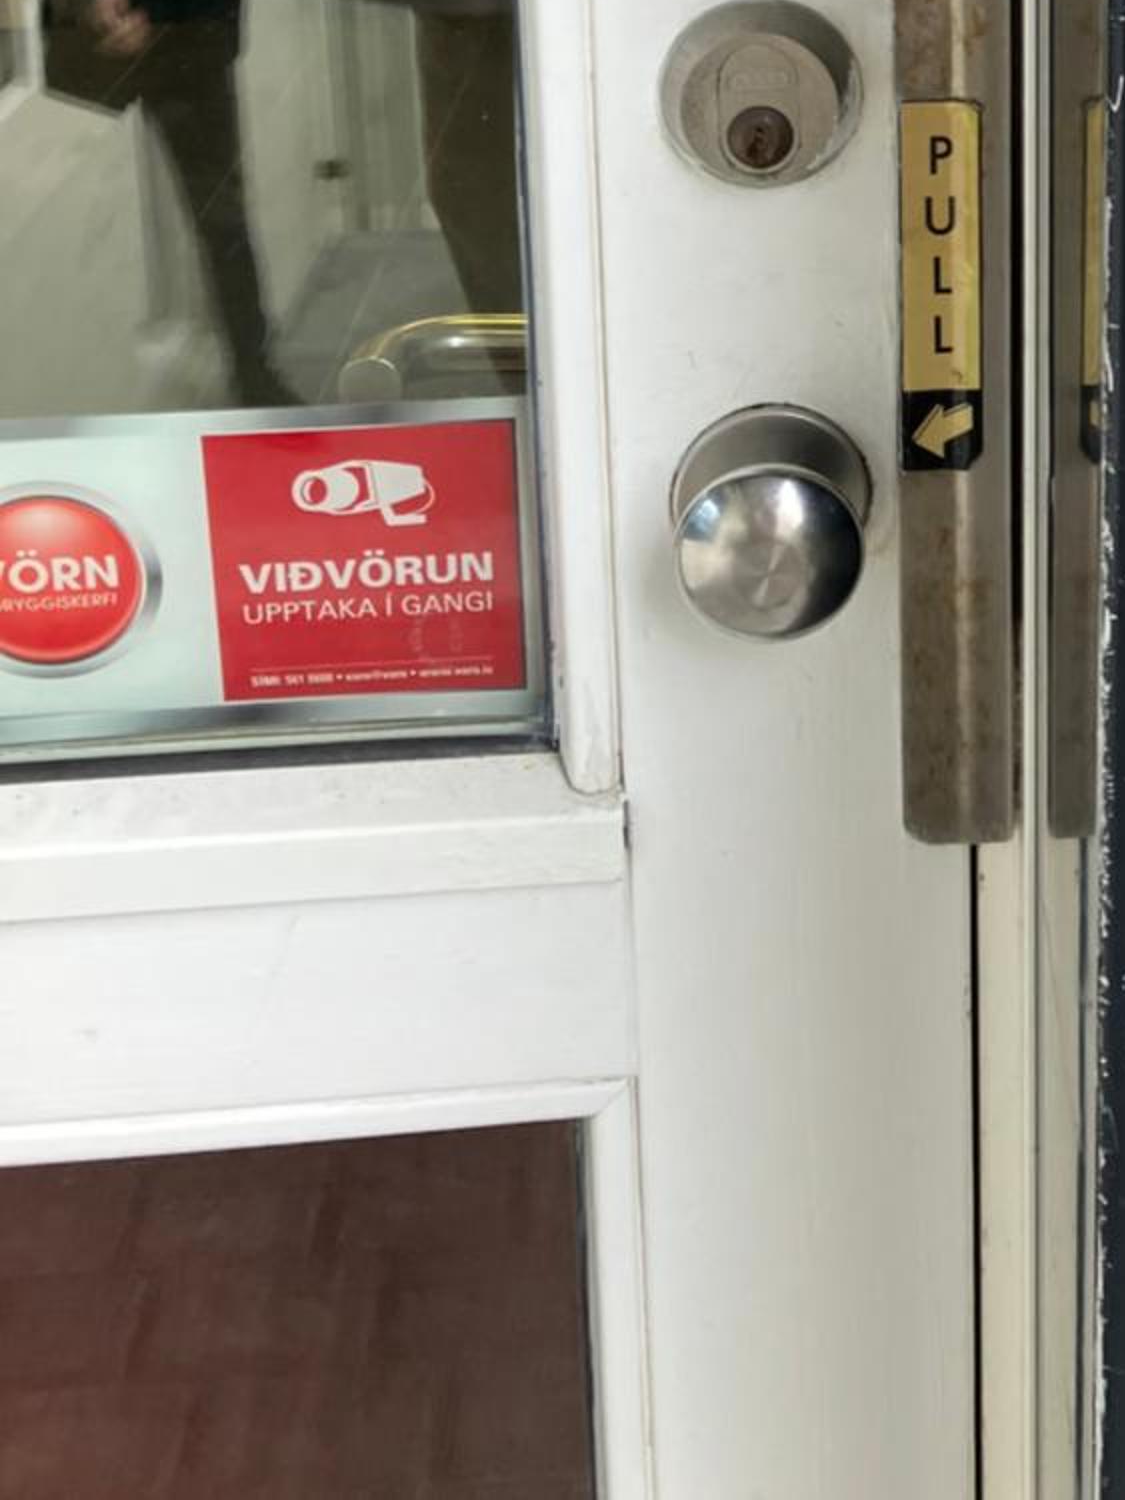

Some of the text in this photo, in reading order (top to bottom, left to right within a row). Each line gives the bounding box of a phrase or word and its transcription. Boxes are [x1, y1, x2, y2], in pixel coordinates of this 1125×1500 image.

[923, 134, 956, 356] PULL
[0, 548, 120, 594] ÖRN
[238, 549, 494, 595] VIÐVÖRUN
[242, 596, 378, 626] UPPTAKA
[400, 589, 494, 617] GANGI
